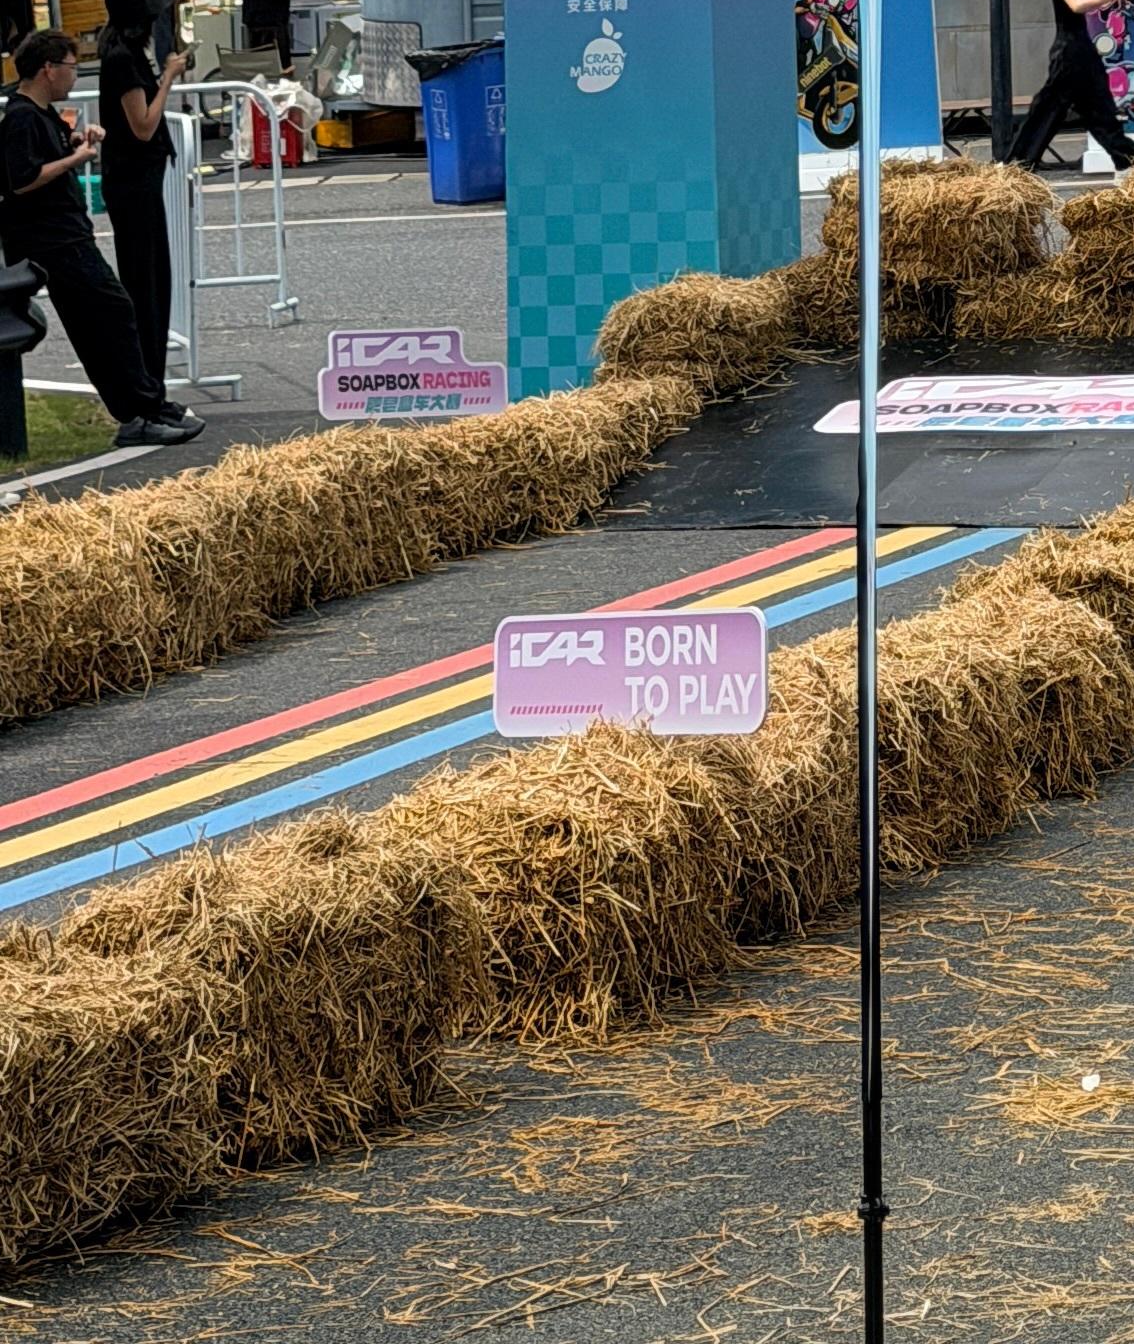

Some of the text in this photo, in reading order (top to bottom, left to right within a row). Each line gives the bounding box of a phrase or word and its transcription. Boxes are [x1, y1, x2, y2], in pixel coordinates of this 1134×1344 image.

[585, 52, 627, 65] CRAZY
[570, 65, 622, 78] MANGO
[800, 57, 832, 88] ninebot
[338, 370, 491, 393] SOAPBOX RACING
[876, 402, 1069, 415] SOAPBOX
[625, 624, 717, 667] BORN
[624, 673, 758, 715] TO PLAY
